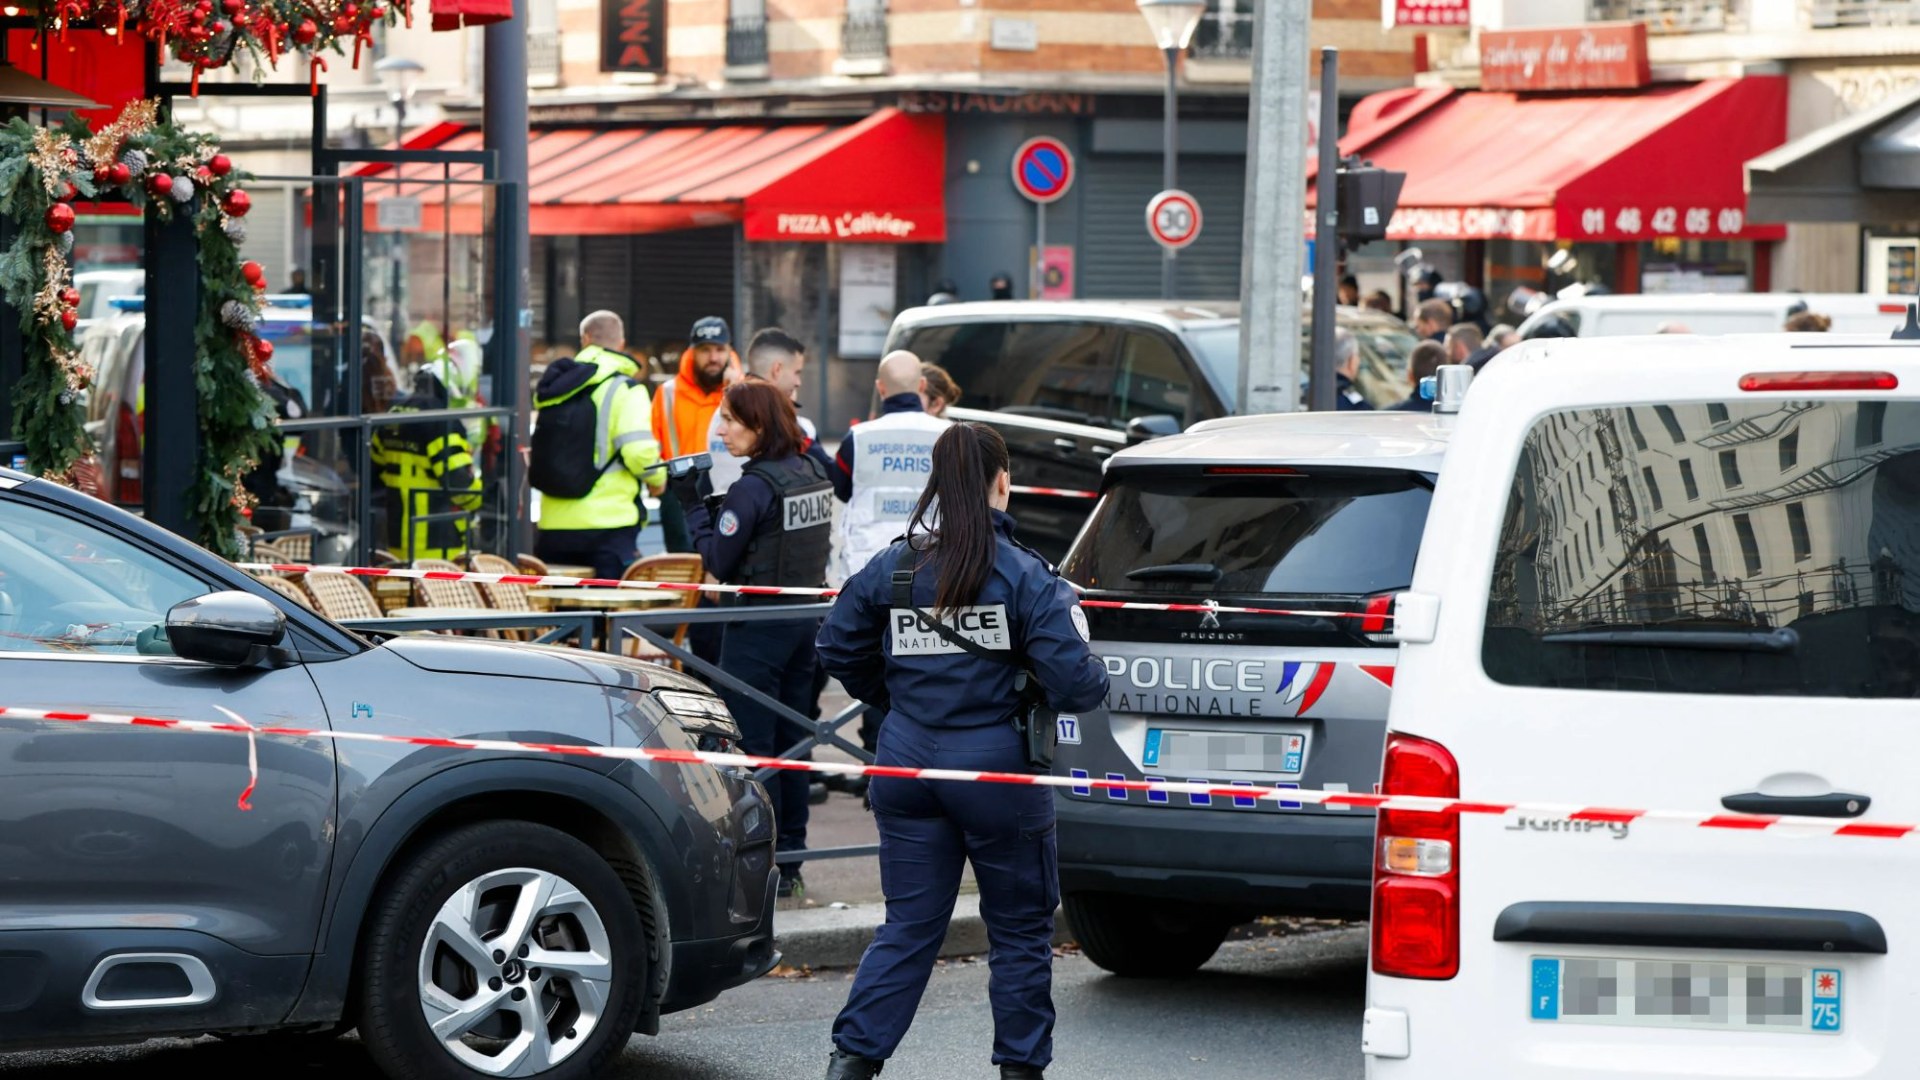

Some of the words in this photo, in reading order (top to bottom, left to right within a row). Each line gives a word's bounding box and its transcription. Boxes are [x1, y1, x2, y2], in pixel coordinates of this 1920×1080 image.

[777, 213, 832, 234] PIZZA
[1160, 209, 1191, 231] 30
[1582, 208, 1605, 234] 01
[1651, 207, 1677, 233] 42
[868, 443, 904, 455] SAPEURS
[882, 456, 931, 473] PARIS
[899, 633, 1002, 649] NATIOALE
[1180, 632, 1245, 640] PEUGEOT
[1102, 655, 1266, 693] POLICE
[1100, 693, 1262, 716] NATIONALE
[1059, 720, 1075, 738] 17
[1286, 755, 1299, 769] 75
[1540, 996, 1550, 1010] F
[1814, 1003, 1838, 1027] 75
